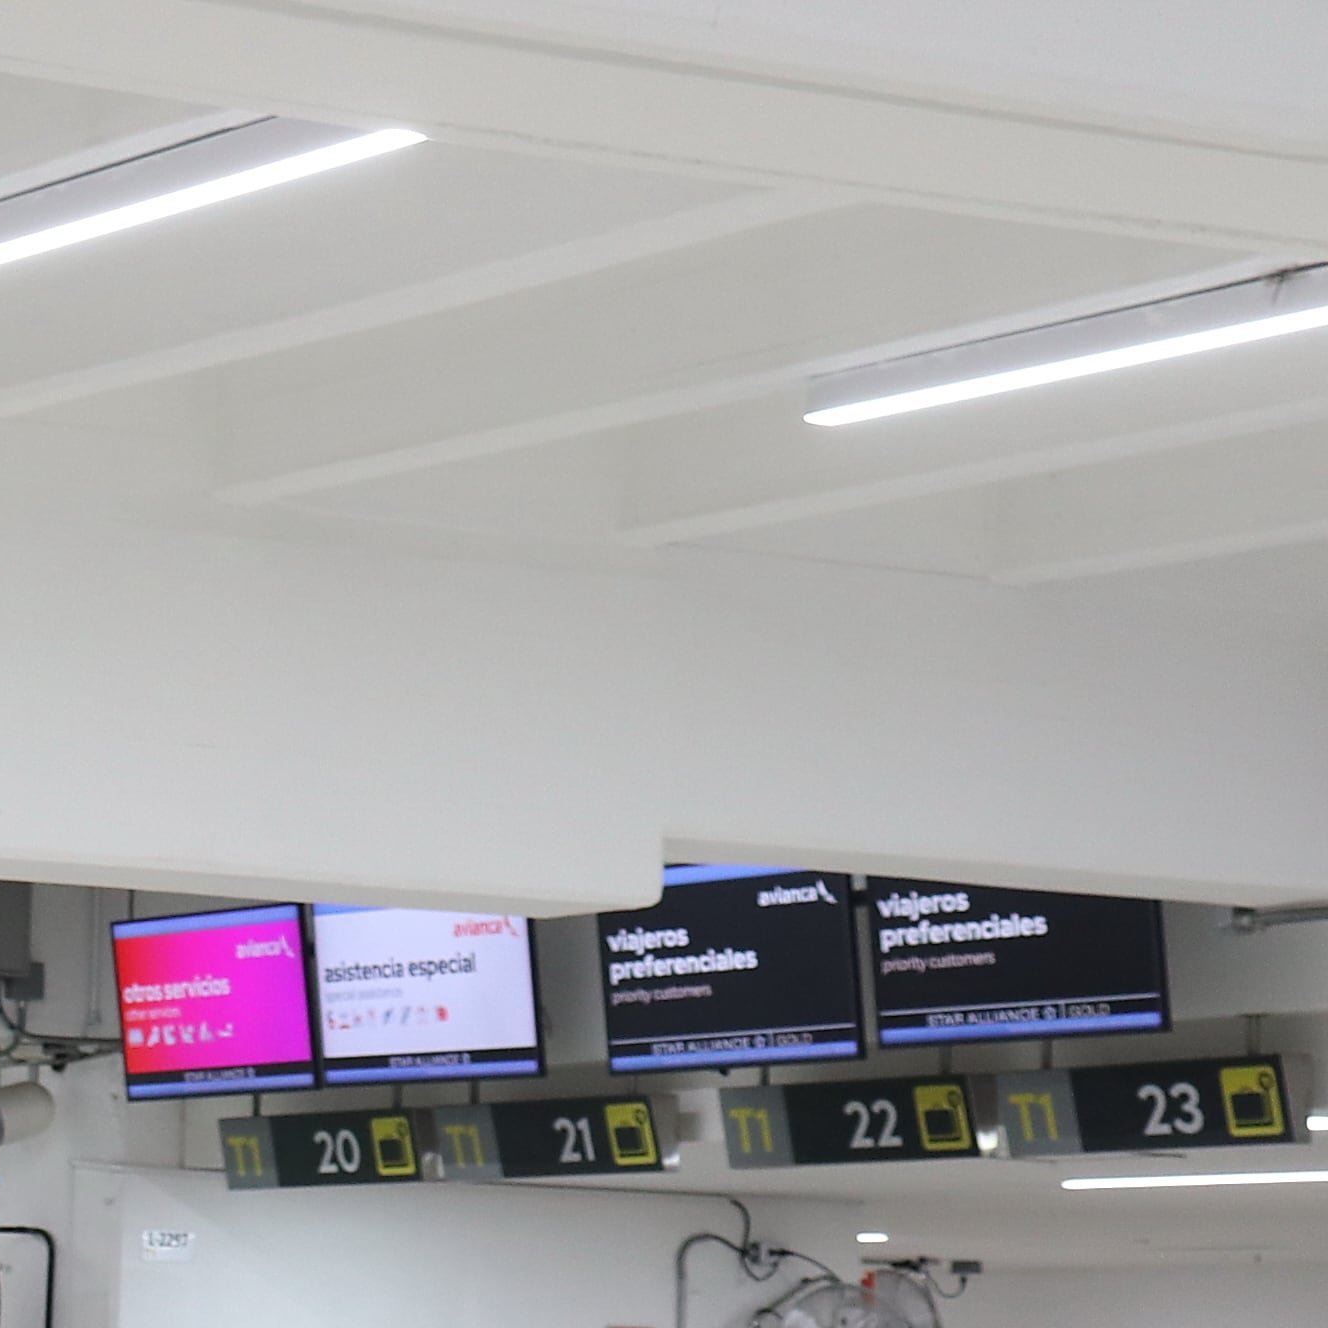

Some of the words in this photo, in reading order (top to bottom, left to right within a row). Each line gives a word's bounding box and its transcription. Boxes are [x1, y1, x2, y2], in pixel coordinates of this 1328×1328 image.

[757, 886, 818, 907] avianca
[876, 891, 970, 921] viajeros
[453, 919, 503, 937] avianca
[606, 926, 689, 956] viajeros
[879, 913, 1048, 953] preferenciales
[324, 957, 405, 983] asistencia
[408, 952, 476, 980] especial
[609, 948, 758, 986] preferenciales
[882, 955, 927, 975] priority
[929, 952, 995, 970] customers
[124, 983, 162, 1004] otros
[164, 974, 231, 1000] servicios
[611, 988, 651, 1006] priority
[653, 985, 712, 1001] customers
[926, 1012, 964, 1027] STAR
[967, 1007, 1040, 1025] ALLIANCE
[687, 1038, 748, 1053] ALLIANCE
[730, 1107, 775, 1152] T1
[844, 1099, 902, 1148] 22
[1008, 1093, 1059, 1141] T1
[1137, 1082, 1204, 1136] 23
[228, 1135, 264, 1177] T1
[313, 1129, 361, 1174] 20
[444, 1124, 484, 1168] T1
[553, 1117, 595, 1163] 21
